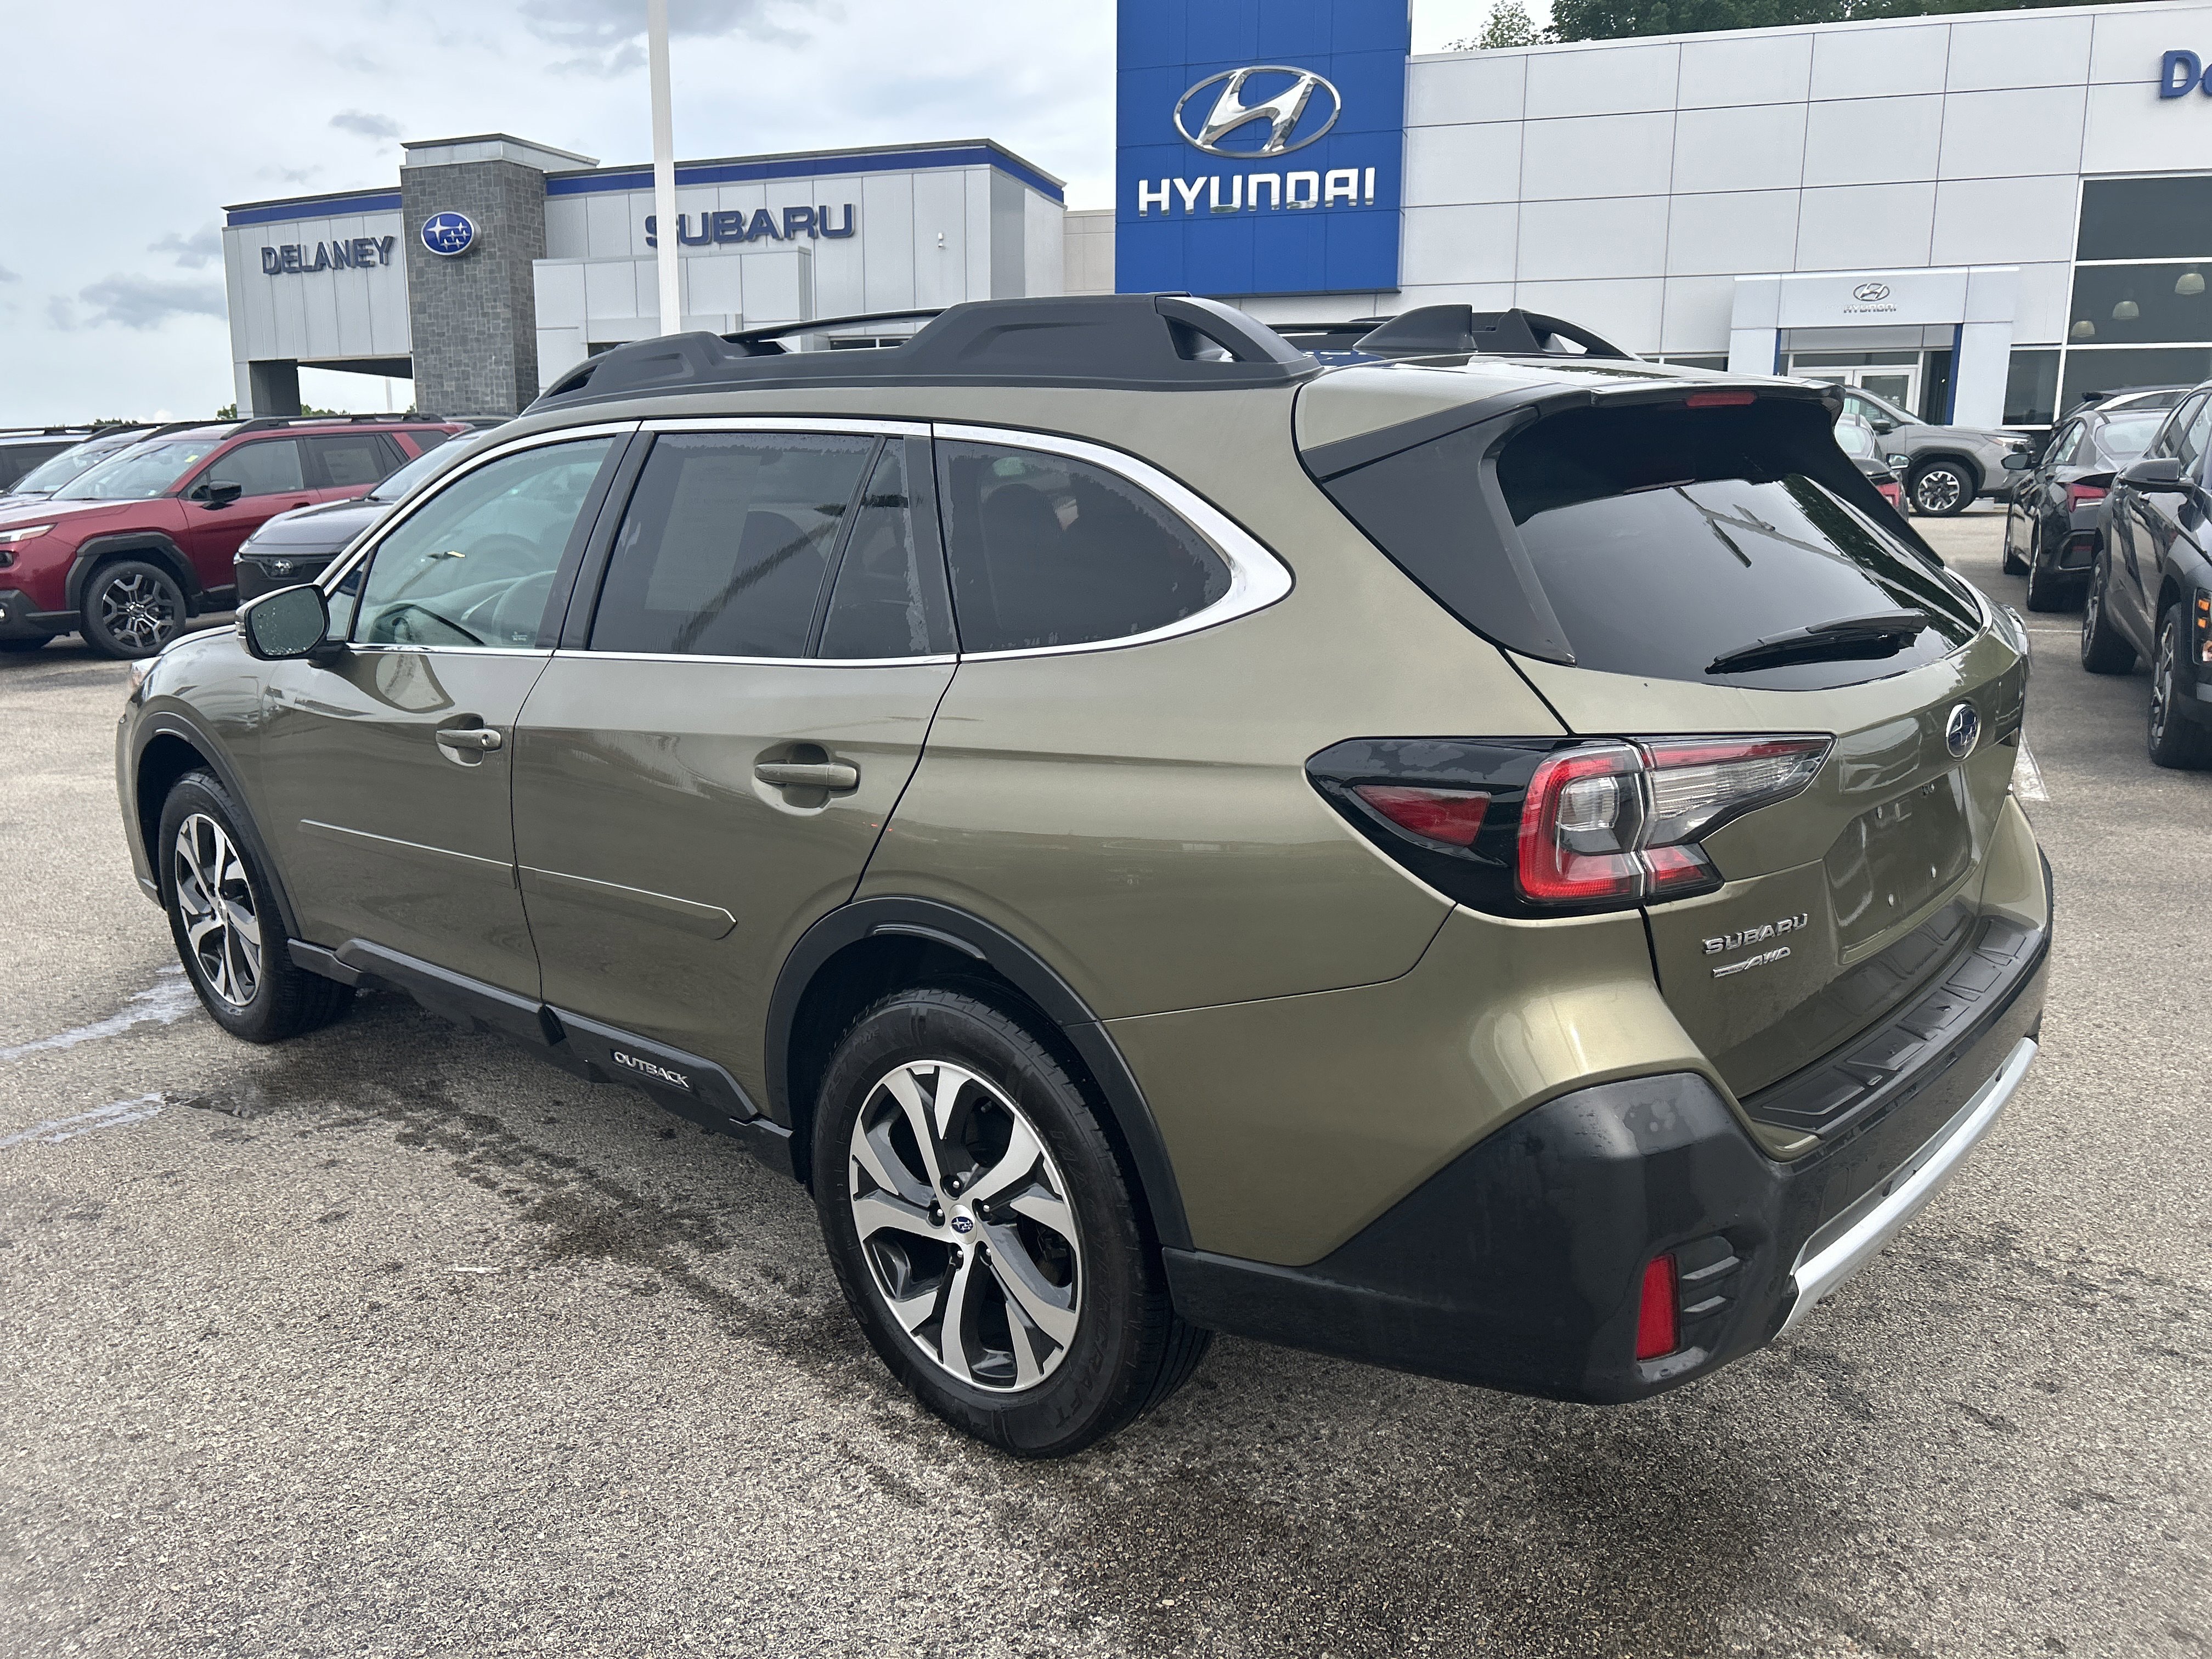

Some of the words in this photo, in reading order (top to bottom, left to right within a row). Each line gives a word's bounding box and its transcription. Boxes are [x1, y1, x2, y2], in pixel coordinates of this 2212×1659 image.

[2160, 49, 2212, 99] D
[1138, 167, 1376, 217] HYUNDAI
[261, 235, 394, 275] DELANEY
[1843, 303, 1897, 313] HYUNDAI
[1702, 913, 1808, 955] SUBARU
[1744, 946, 1792, 970] AWD
[614, 1051, 690, 1088] OUTBACK
